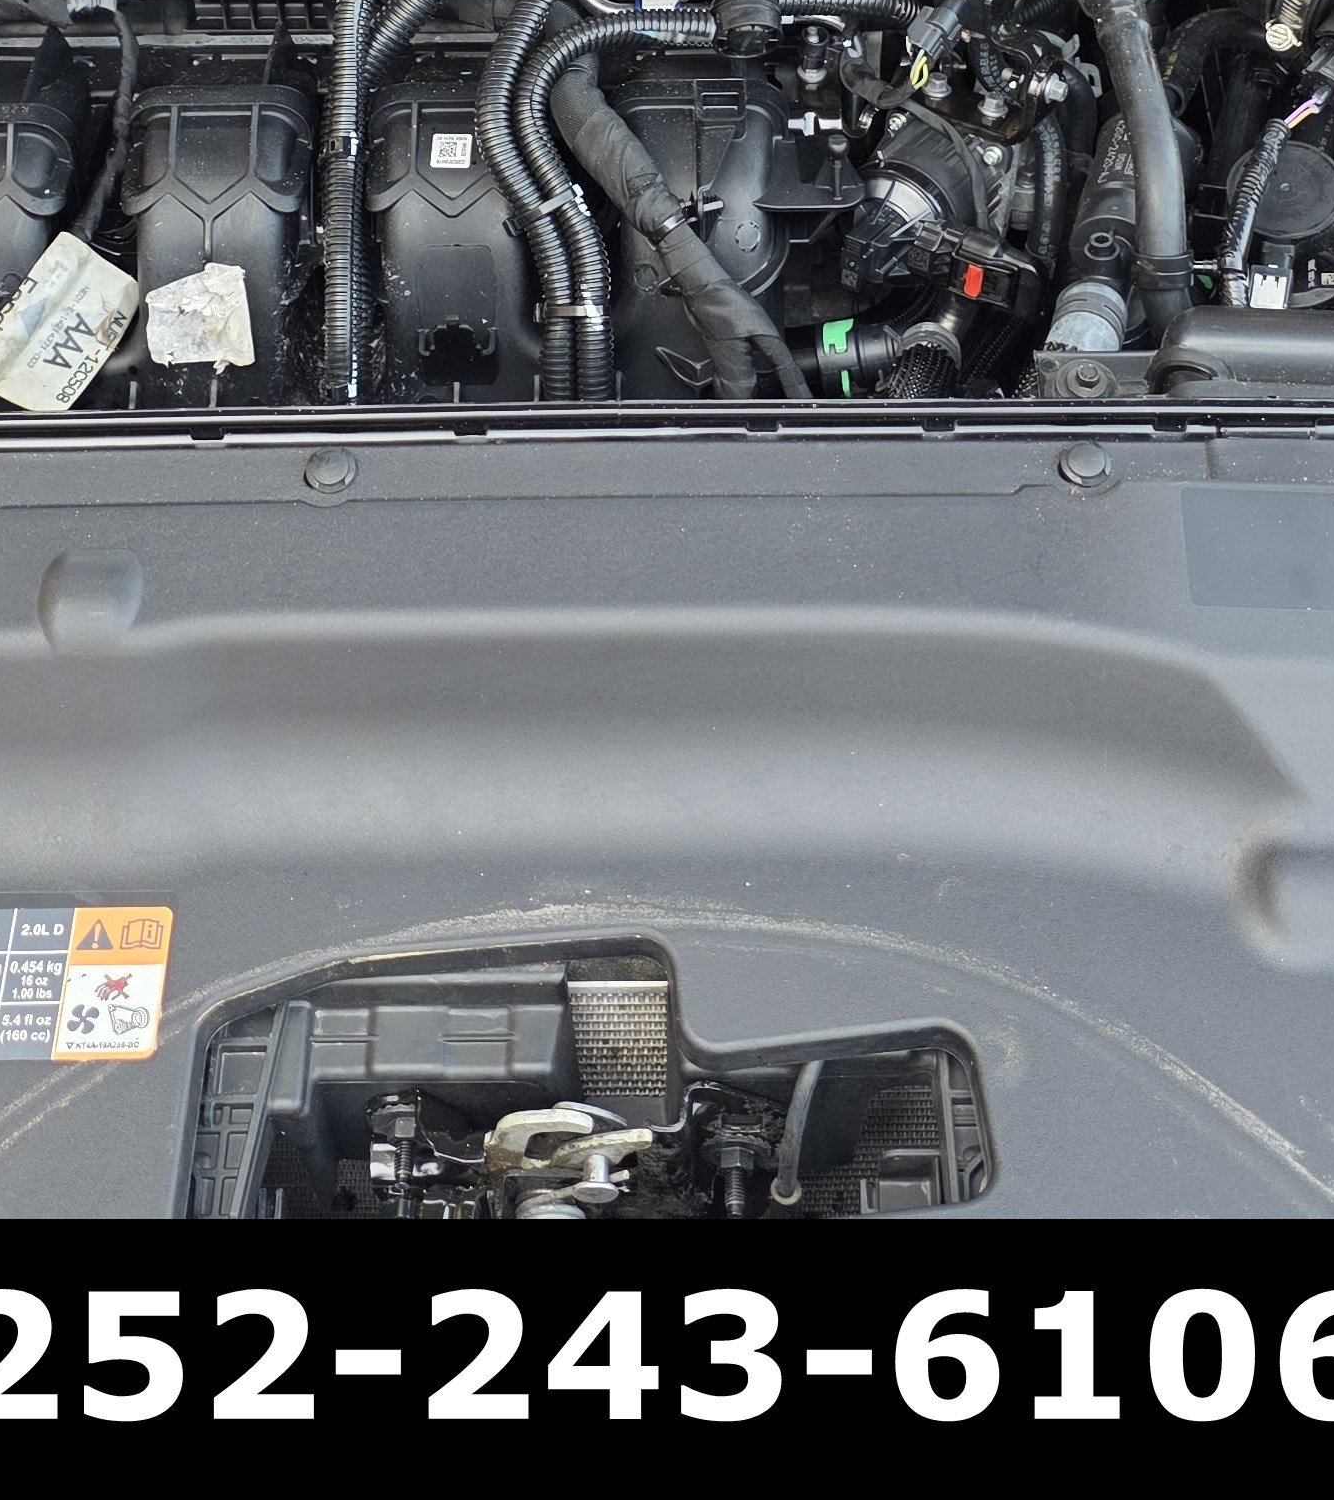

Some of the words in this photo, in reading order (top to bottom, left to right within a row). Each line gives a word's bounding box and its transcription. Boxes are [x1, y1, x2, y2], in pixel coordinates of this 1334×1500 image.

[42, 312, 97, 370] AAA
[20, 923, 51, 937] 2.0L
[53, 924, 65, 936] D
[9, 960, 45, 974] 0.454
[46, 960, 63, 976] kg
[20, 975, 35, 987] 16
[36, 977, 49, 987] oz
[11, 987, 34, 1000] 1.00
[35, 987, 53, 1000] lbs
[1, 1014, 21, 1027] 5.4
[23, 1014, 35, 1027] fl
[36, 1016, 52, 1027] oz
[0, 1029, 28, 1044] (160
[30, 1029, 51, 1044] cc)
